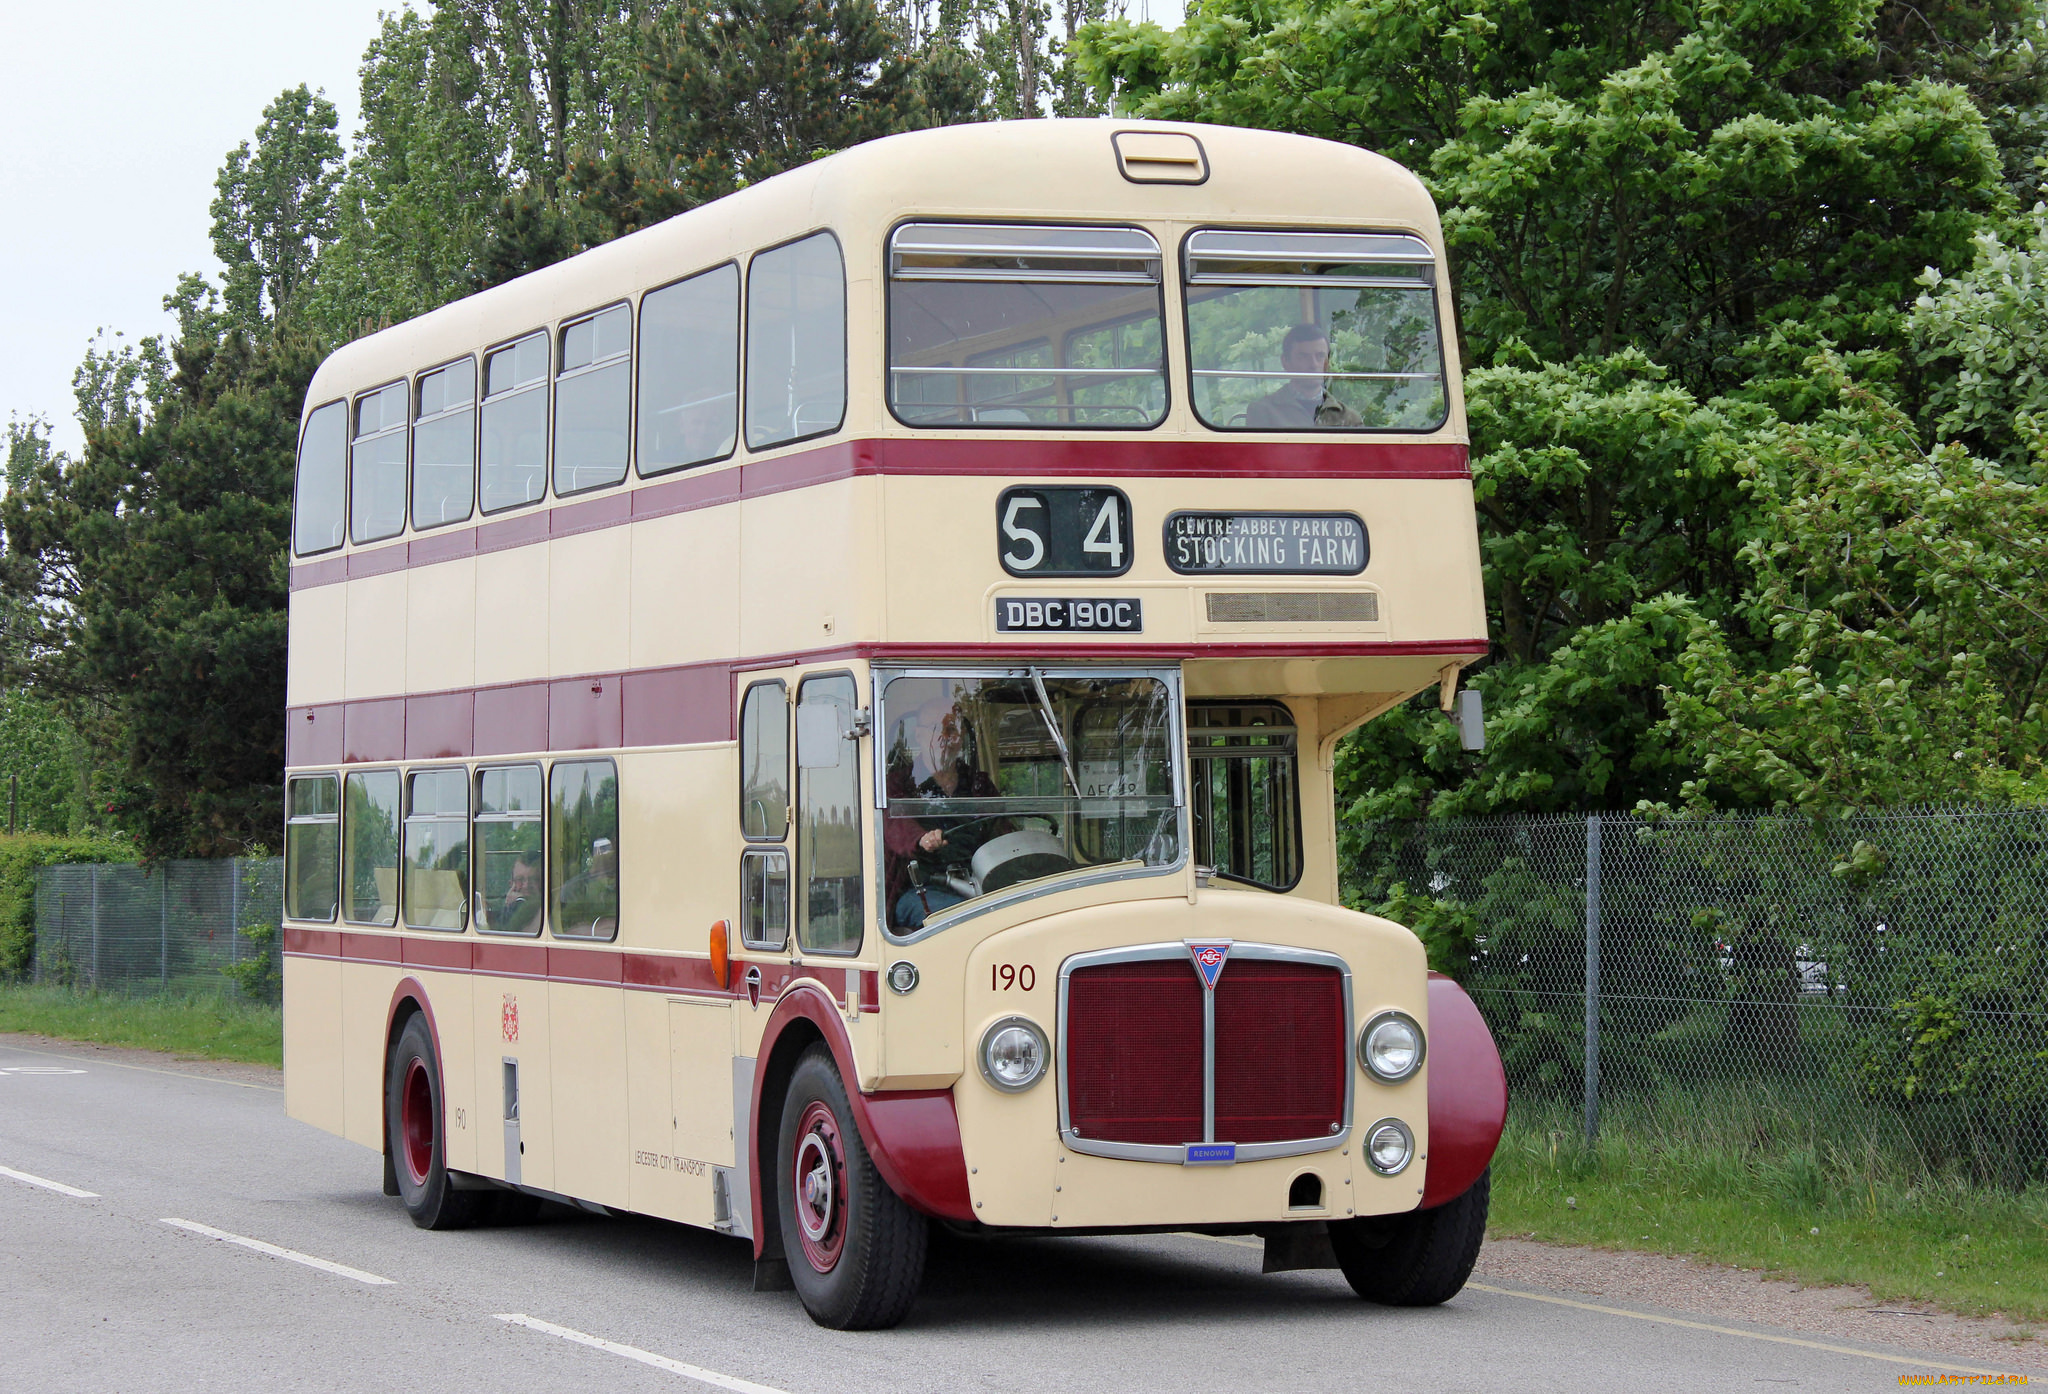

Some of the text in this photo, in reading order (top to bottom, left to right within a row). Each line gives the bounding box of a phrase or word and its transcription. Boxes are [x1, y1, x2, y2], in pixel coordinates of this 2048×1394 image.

[1002, 496, 1124, 570] 5 4
[1176, 519, 1357, 537] CENTRE-ABBEY PARK RD.
[1177, 537, 1358, 566] STOCKING FARM
[1200, 953, 1221, 961] AEC
[992, 964, 1036, 992] 190
[455, 1106, 467, 1130] 190
[635, 1149, 706, 1177] LEICESTER CITY TRANSPORT
[1194, 1149, 1230, 1157] RENOWN
